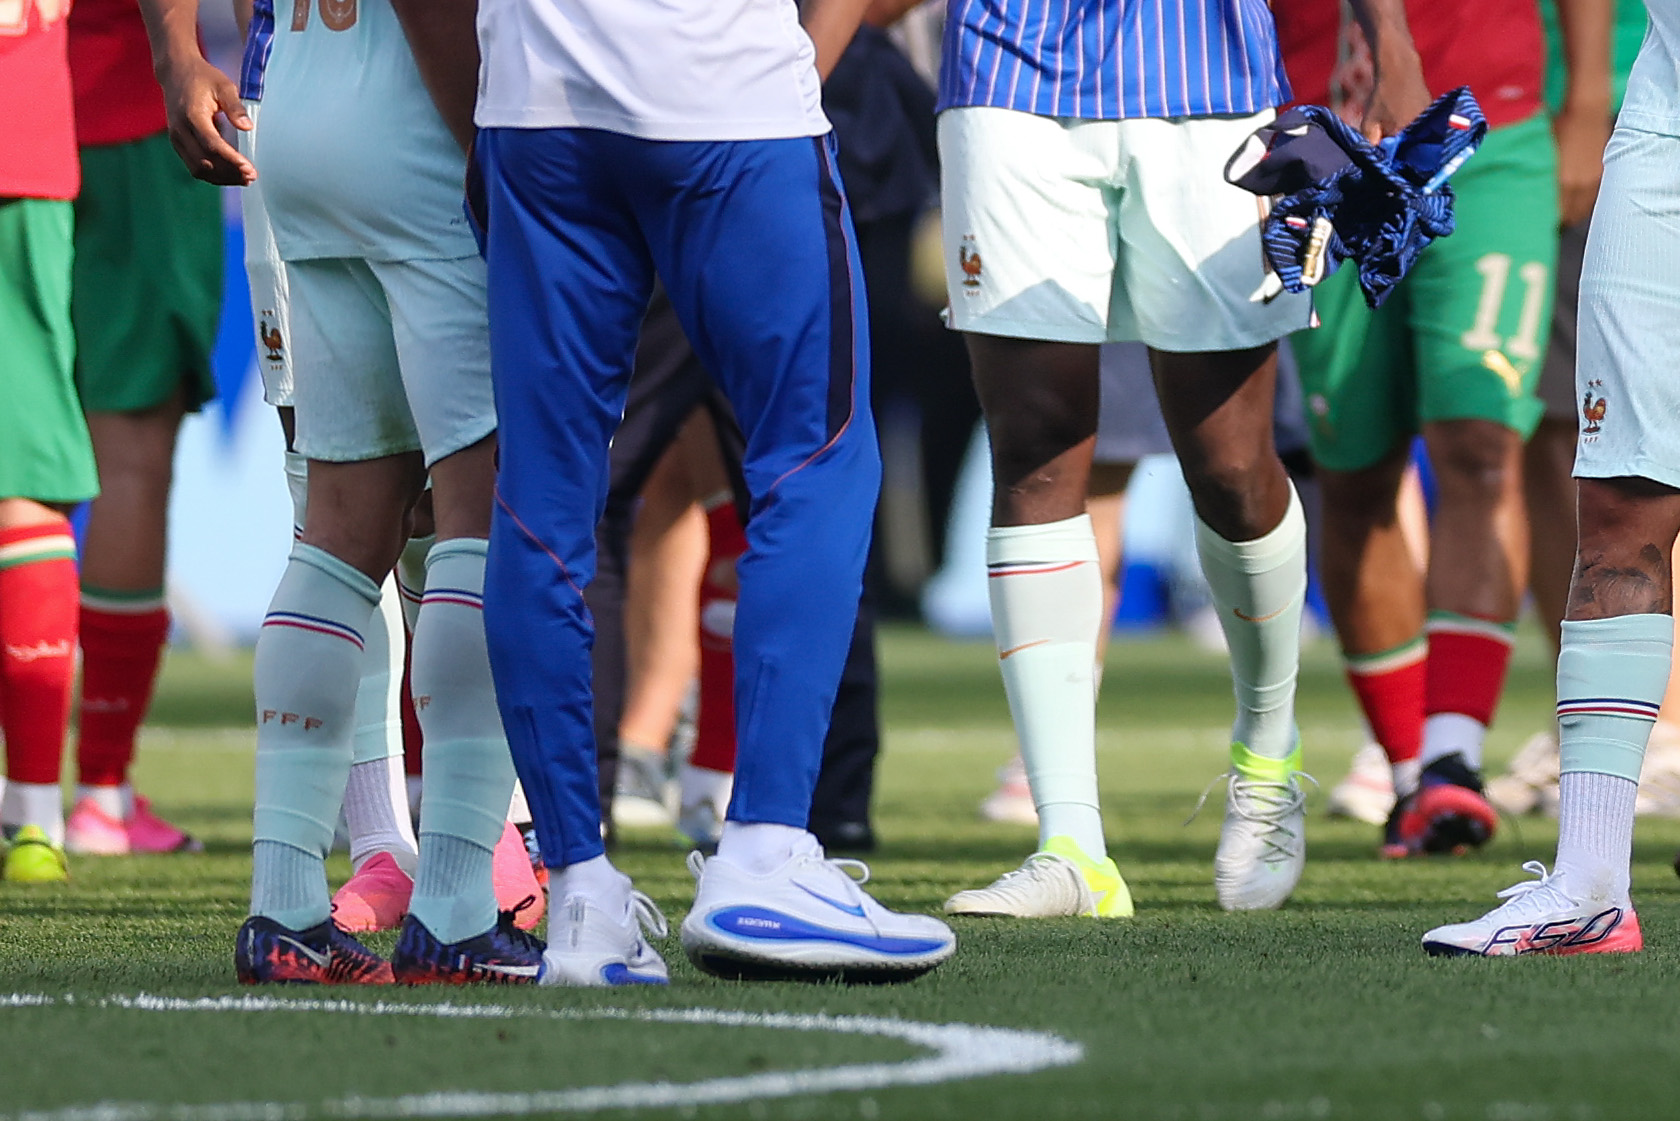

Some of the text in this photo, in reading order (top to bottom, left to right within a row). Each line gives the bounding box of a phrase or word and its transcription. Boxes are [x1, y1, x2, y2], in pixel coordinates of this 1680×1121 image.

[1460, 251, 1549, 360] 11
[262, 709, 323, 731] FFF
[1482, 906, 1623, 957] F50
